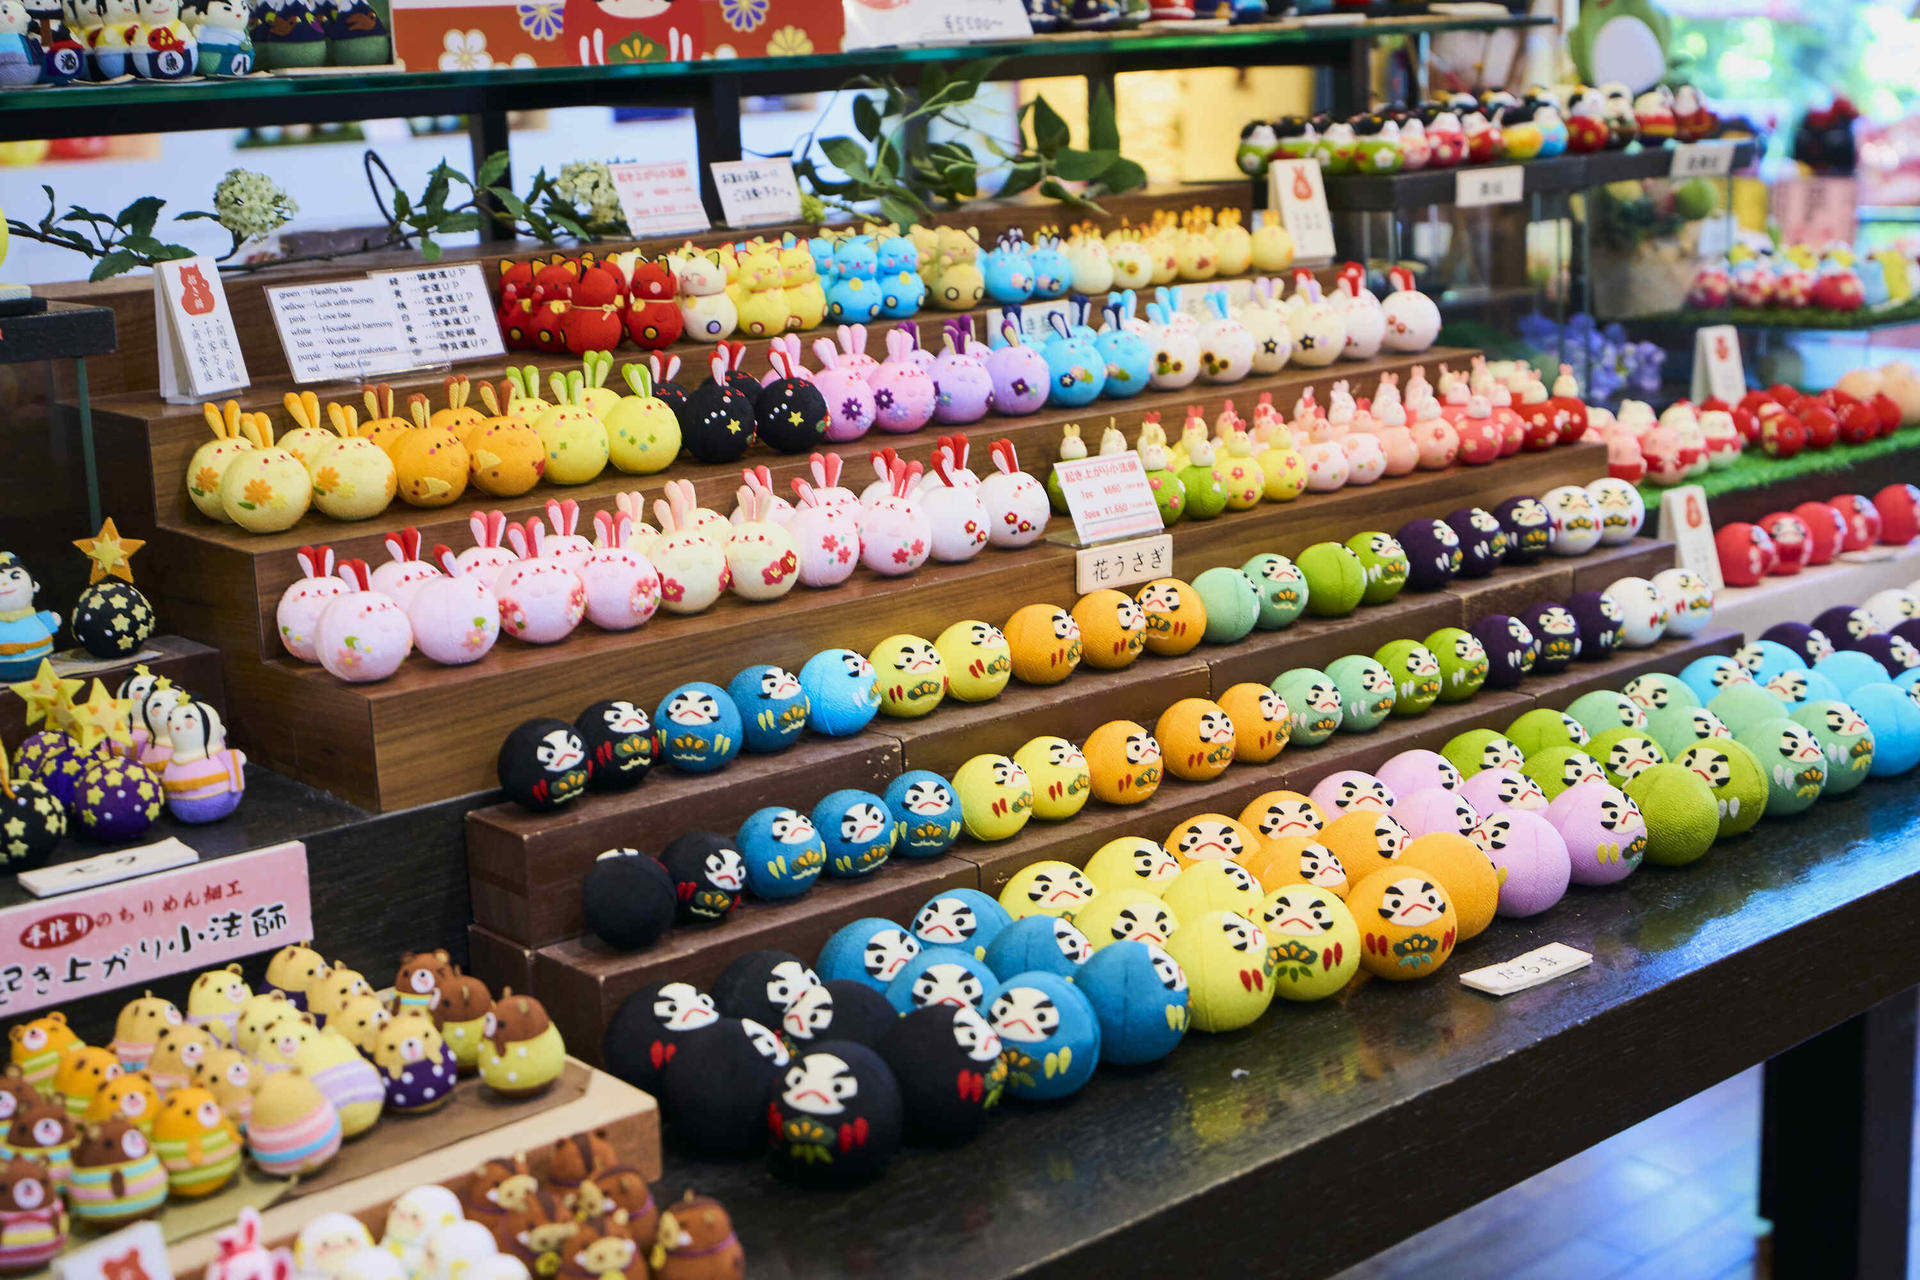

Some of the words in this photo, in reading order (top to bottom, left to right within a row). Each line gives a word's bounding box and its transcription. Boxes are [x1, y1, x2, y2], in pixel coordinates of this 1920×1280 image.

[1092, 546, 1165, 582] 花うさぎ
[1498, 956, 1558, 980] だるま
